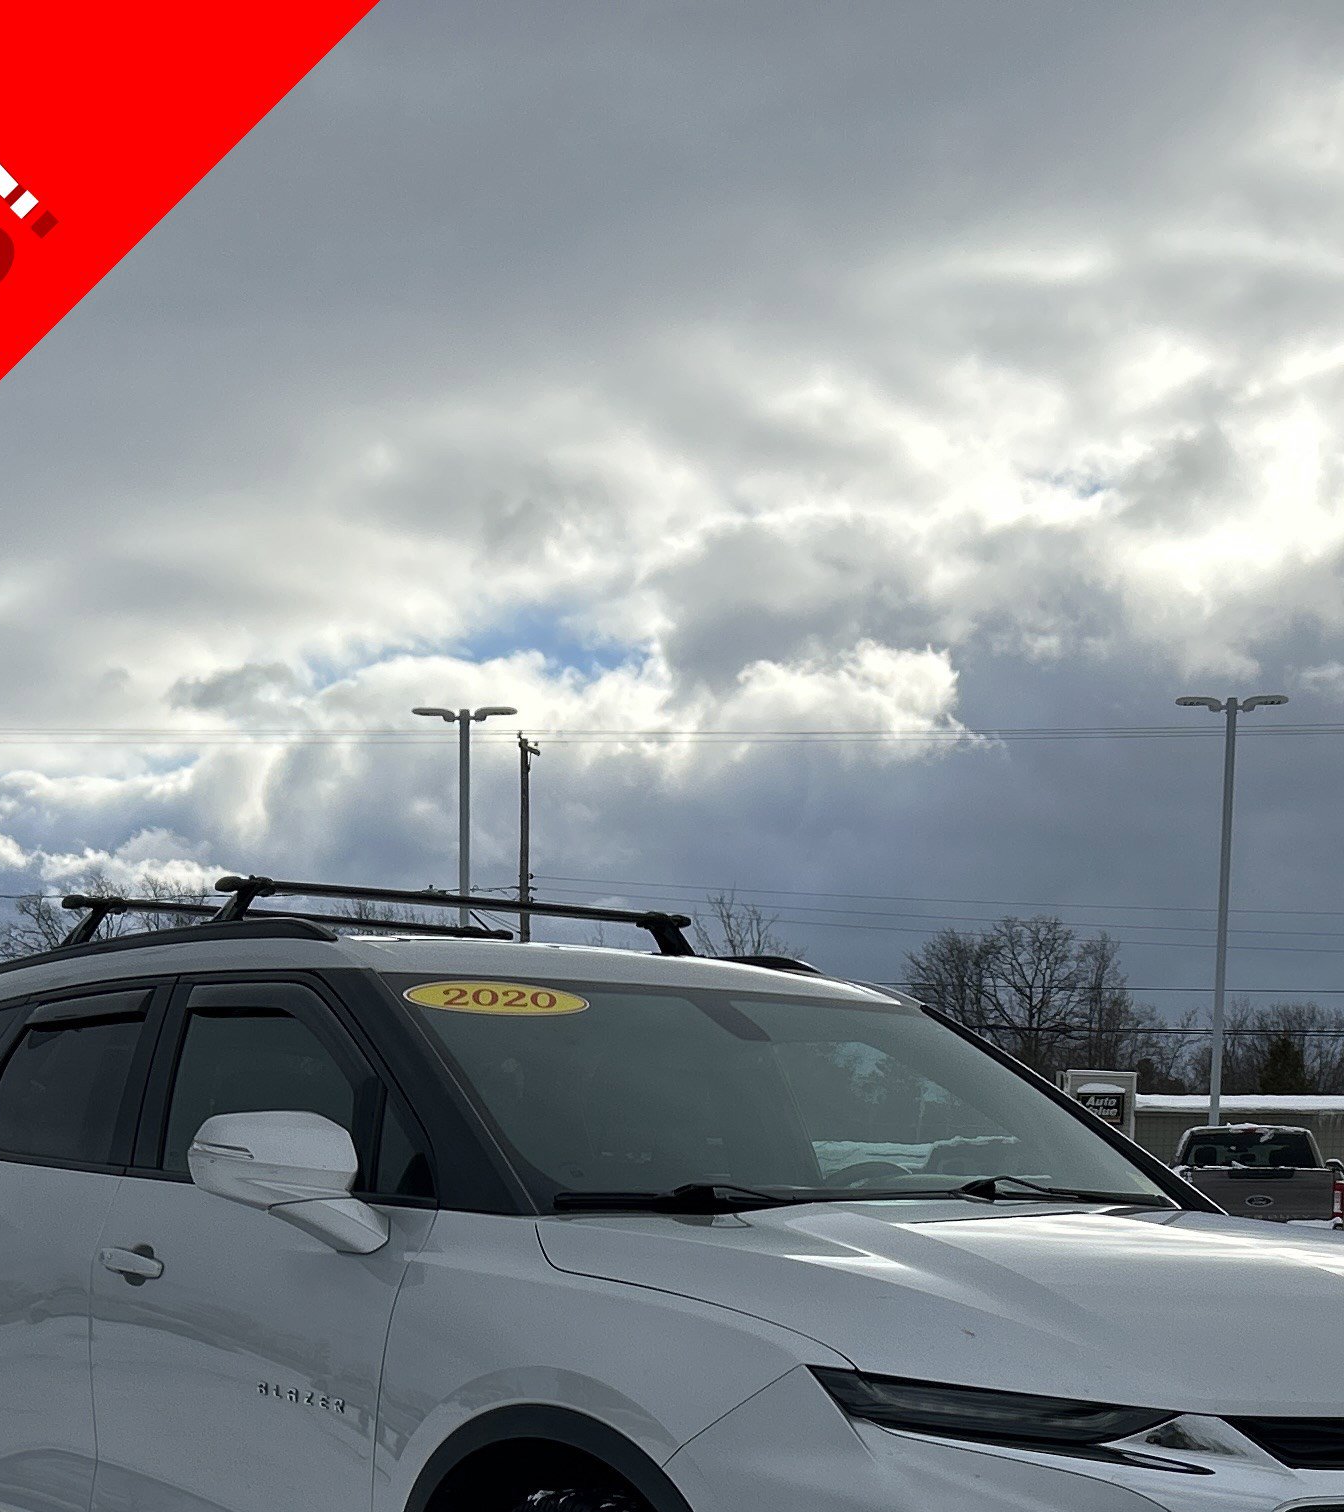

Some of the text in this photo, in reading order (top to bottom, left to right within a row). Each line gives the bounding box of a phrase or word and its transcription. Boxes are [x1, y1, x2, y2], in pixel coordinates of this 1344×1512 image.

[442, 988, 557, 1008] 2020
[1086, 1096, 1117, 1107] Auto
[257, 1380, 346, 1414] BLAZER
